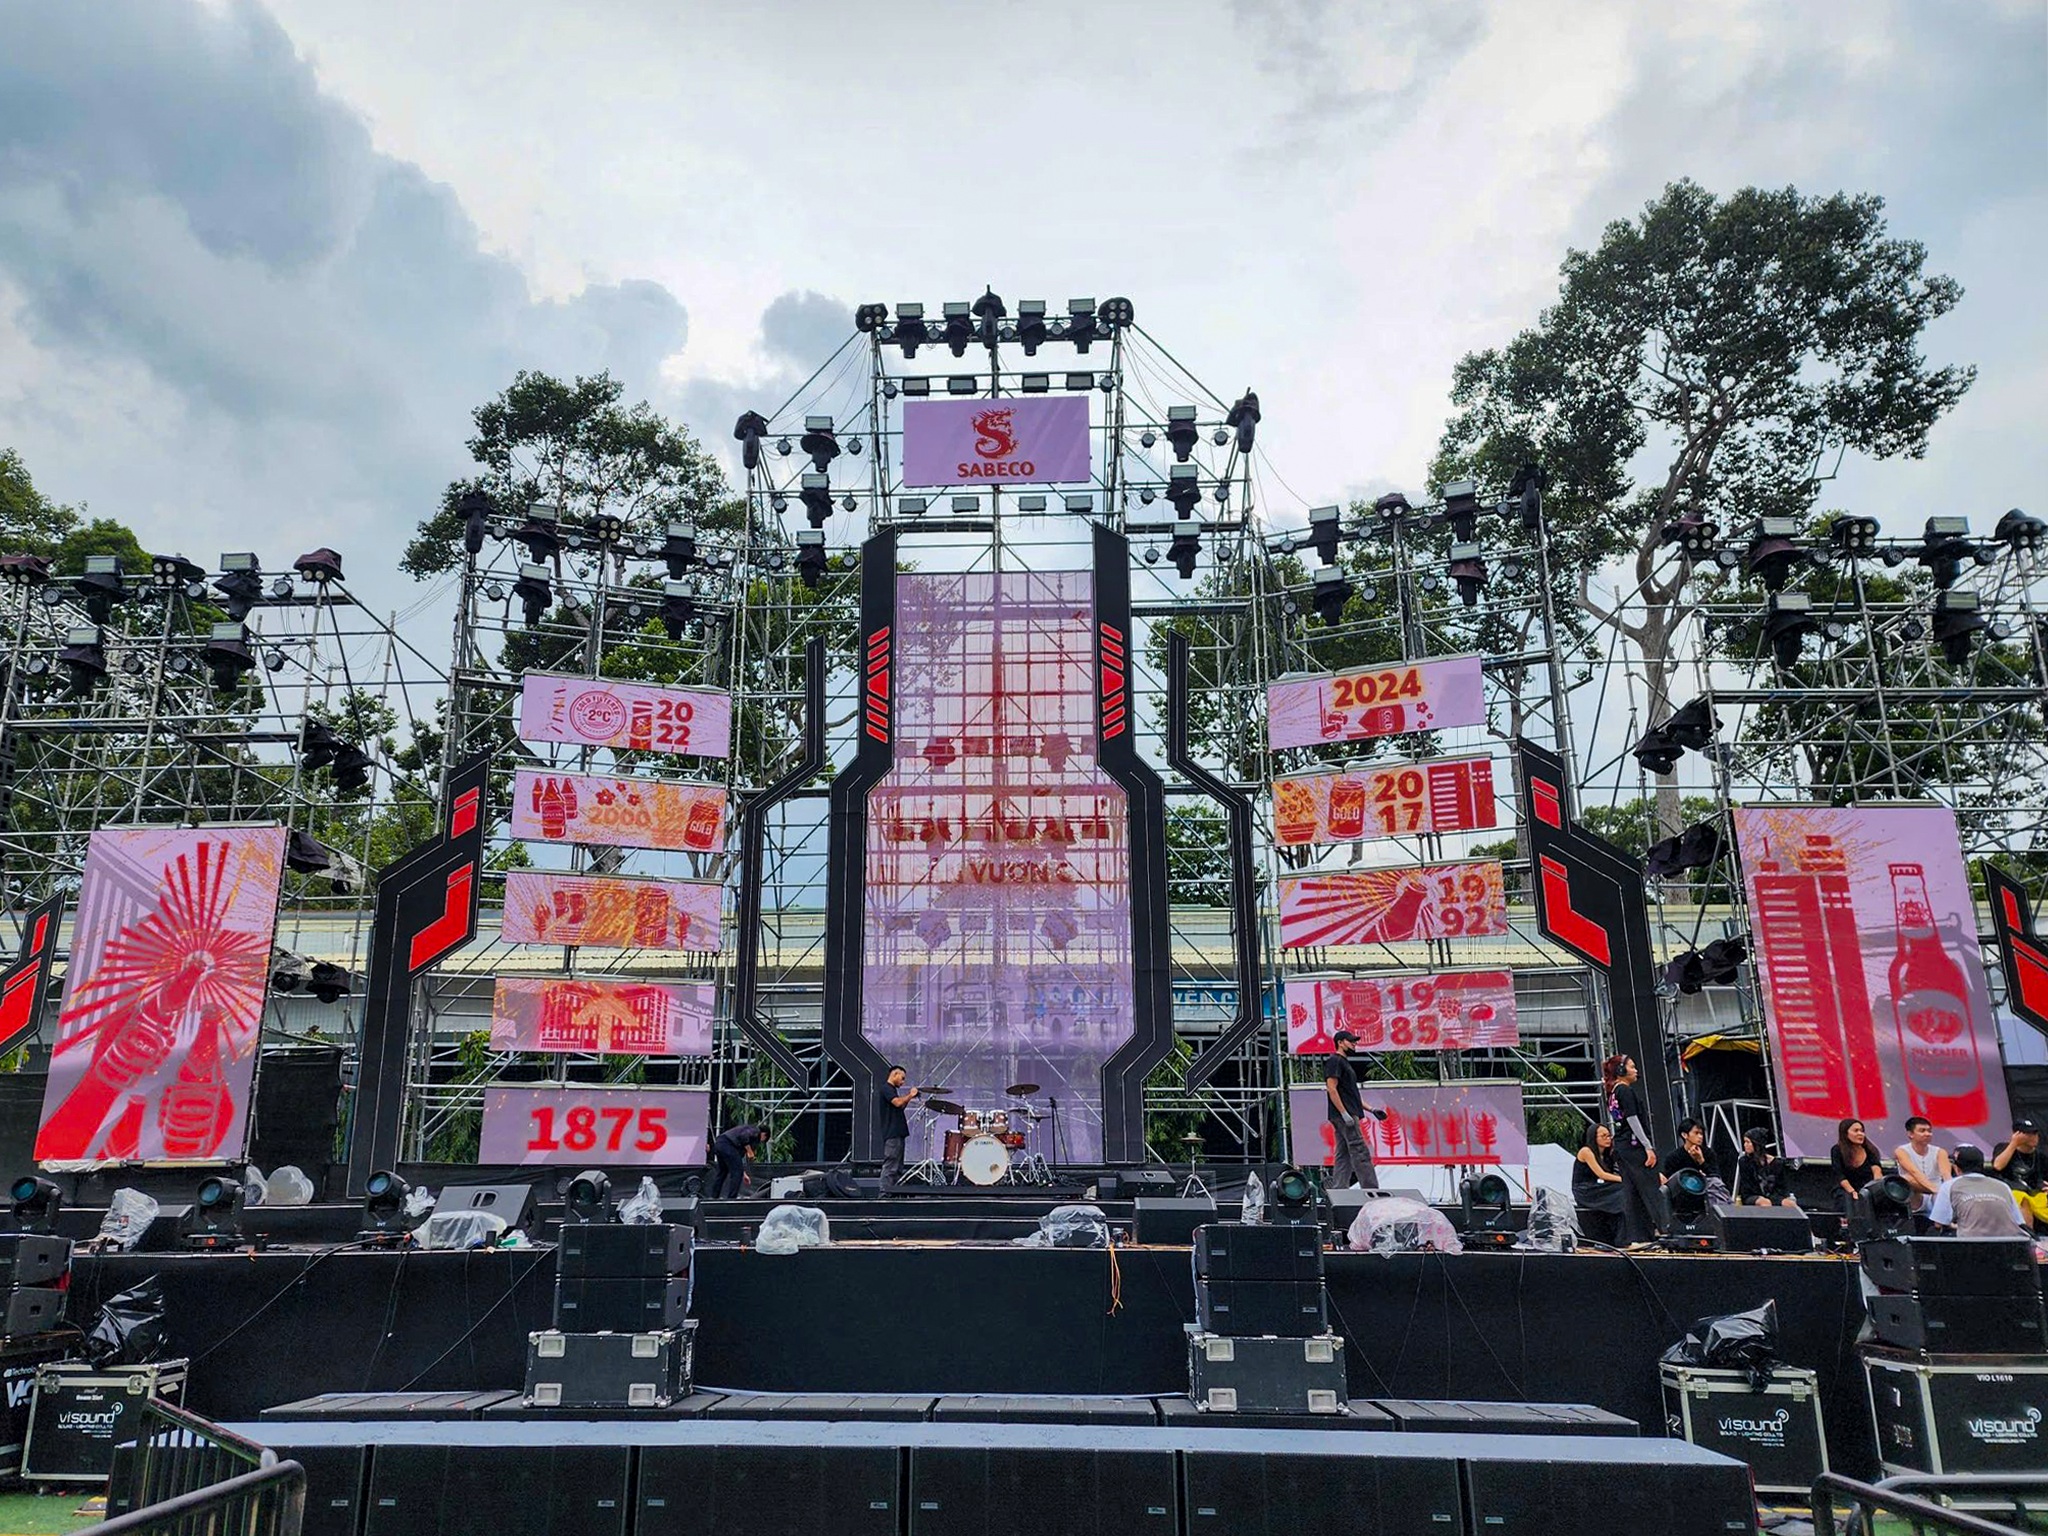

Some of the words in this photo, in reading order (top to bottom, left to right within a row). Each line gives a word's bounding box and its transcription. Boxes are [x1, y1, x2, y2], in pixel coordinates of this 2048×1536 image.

[957, 461, 1035, 478] SABECO
[1333, 668, 1422, 708] 2024
[656, 699, 694, 723] 20
[656, 723, 691, 746] 22
[1373, 770, 1425, 802] 20
[588, 805, 651, 827] 2000
[1377, 801, 1424, 833] 17
[1437, 874, 1486, 904] 19
[1440, 905, 1490, 936] 92
[1387, 982, 1435, 1012] 19
[1390, 1015, 1440, 1046] 85
[527, 1106, 668, 1152] 1875
[59, 1410, 116, 1424] visound
[1718, 1417, 1783, 1432] visound
[1968, 1418, 2036, 1433] visound
